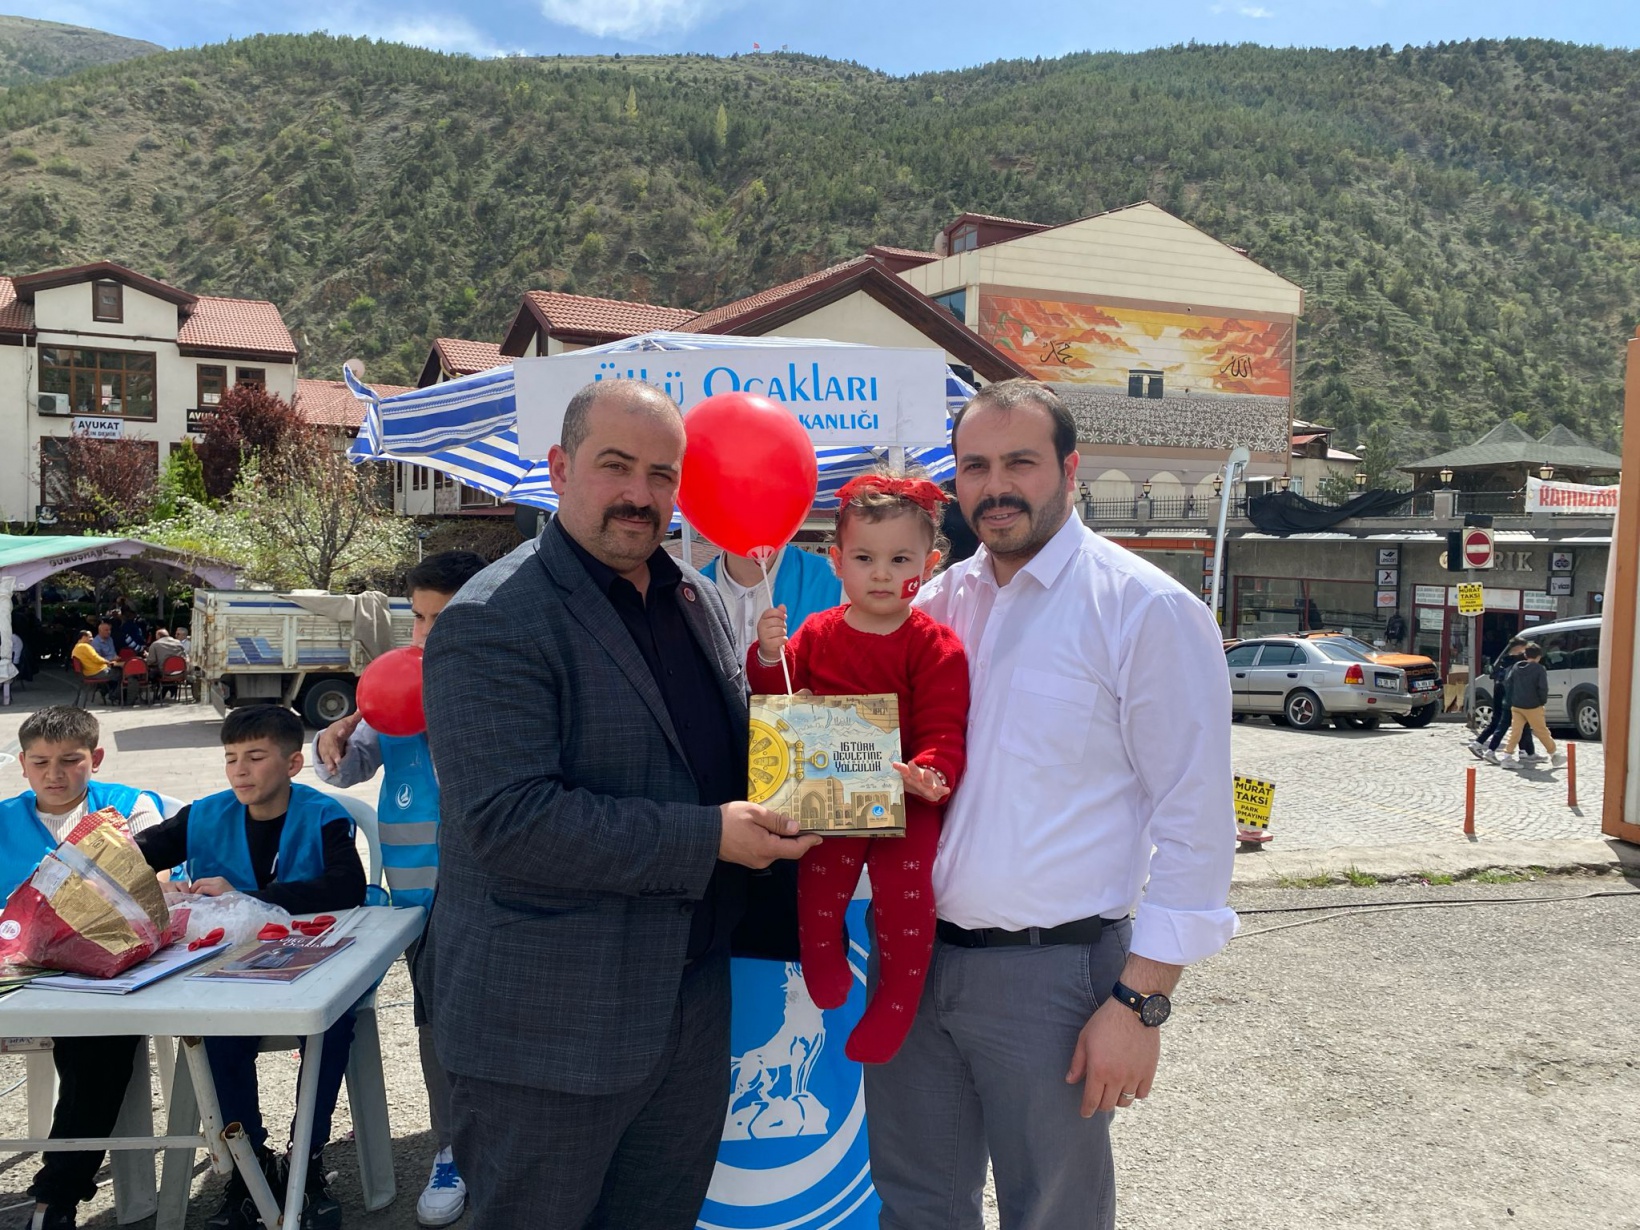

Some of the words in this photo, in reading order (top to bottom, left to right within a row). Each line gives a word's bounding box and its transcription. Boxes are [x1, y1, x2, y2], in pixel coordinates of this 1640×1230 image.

[78, 420, 120, 431] AVUKAT
[799, 409, 879, 430] KANLIĞI
[1539, 485, 1618, 507] RAMAZAN
[840, 741, 850, 752] 16
[850, 741, 875, 752] TÜRK
[835, 760, 882, 772] YOLCULUK
[1235, 782, 1272, 796] MURAT
[1236, 791, 1268, 805] TAKSİ
[1241, 804, 1259, 813] PARK
[1236, 810, 1269, 822] PMAYINIZ
